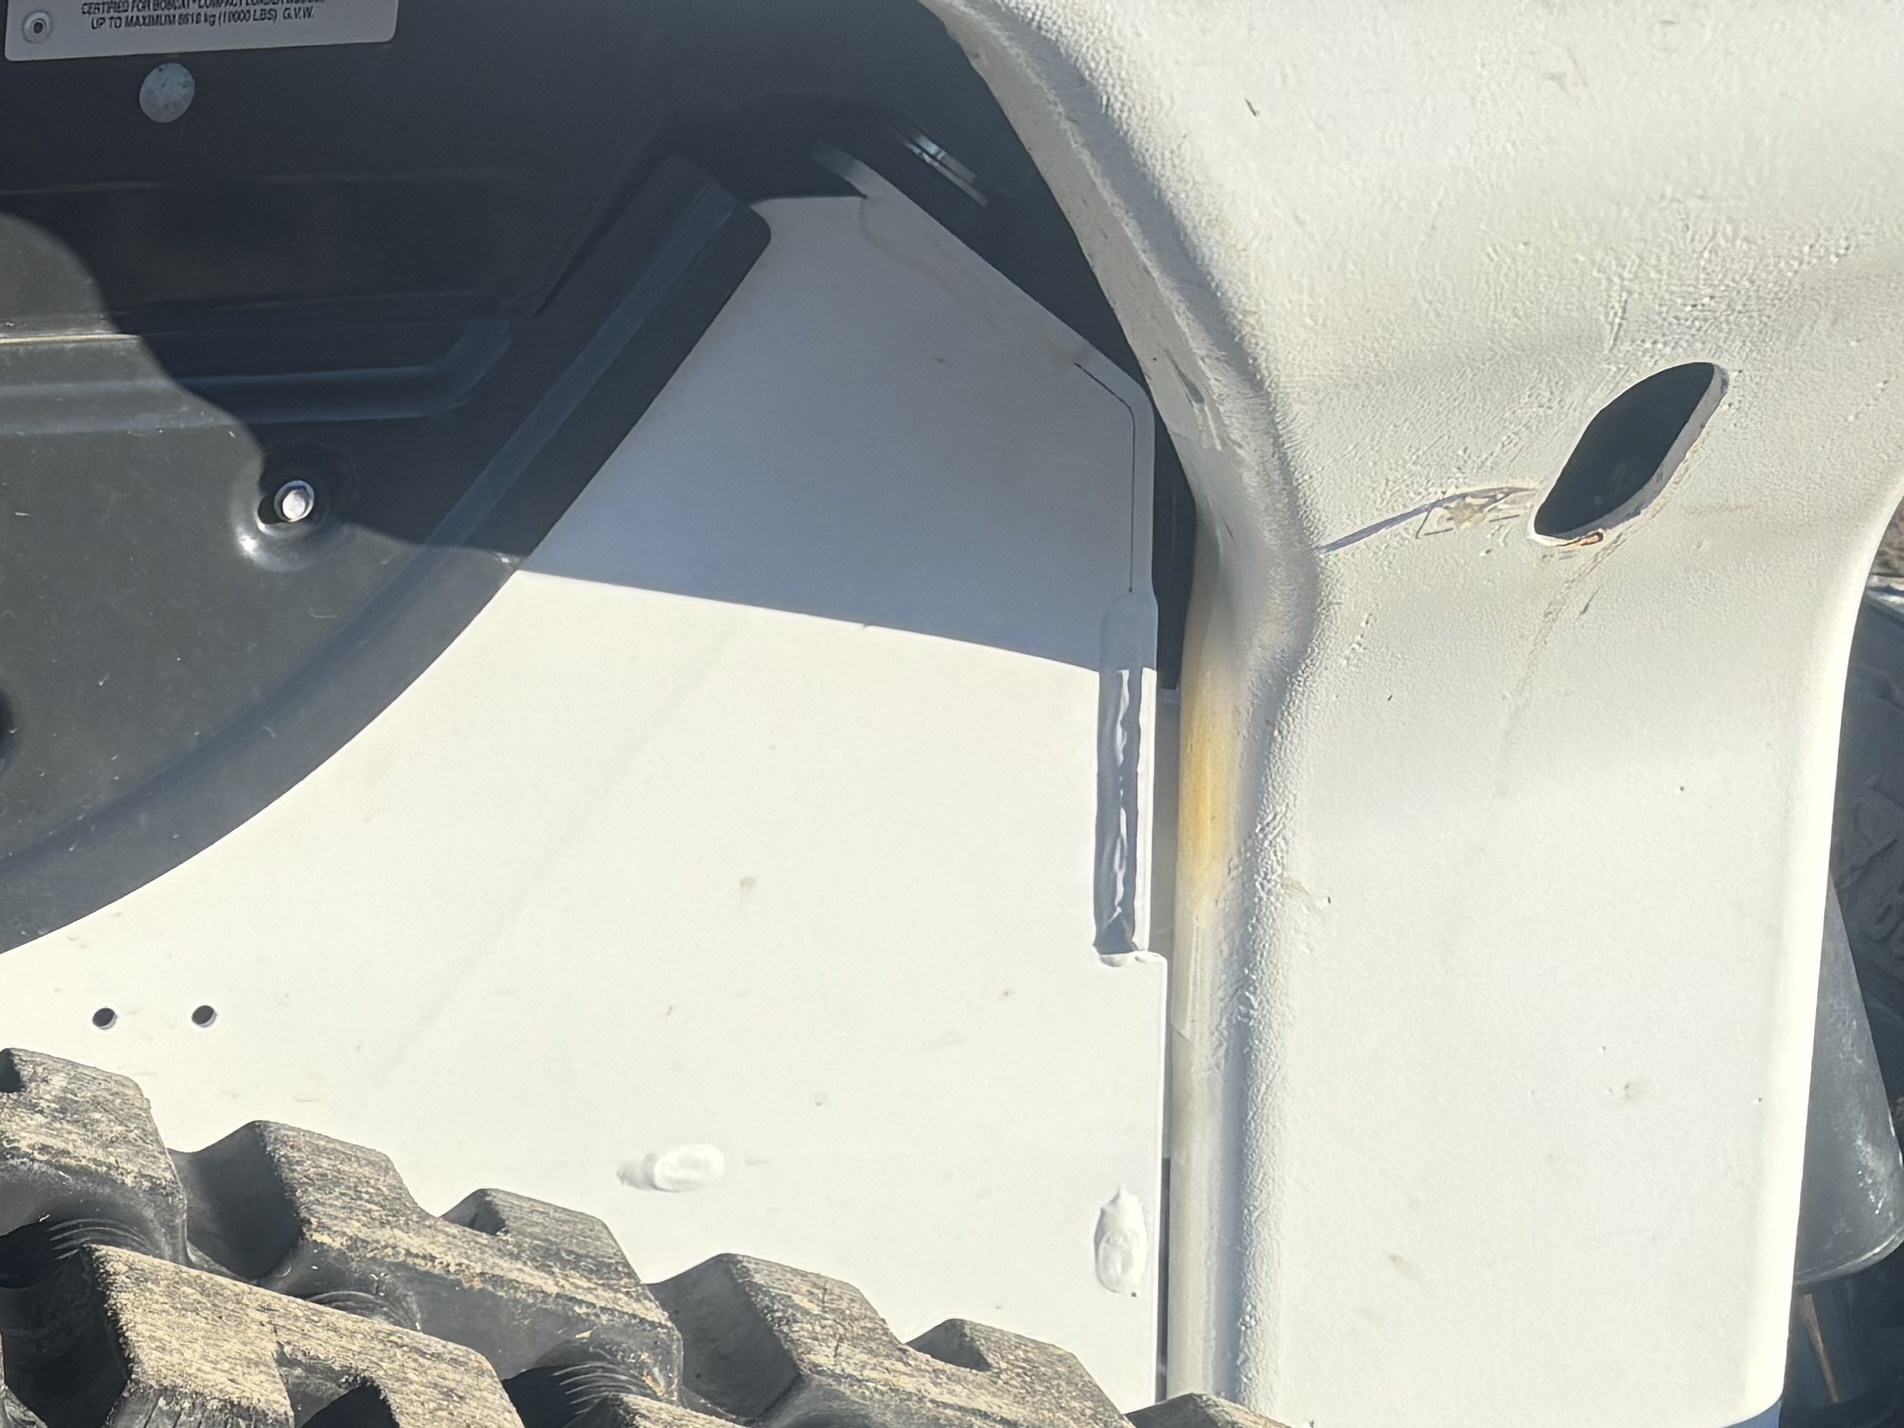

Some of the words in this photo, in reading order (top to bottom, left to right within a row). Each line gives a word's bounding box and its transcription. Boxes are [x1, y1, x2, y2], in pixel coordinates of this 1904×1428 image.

[91, 16, 106, 30] UP
[108, 16, 122, 28] TO
[124, 14, 176, 27] MAXIMUM
